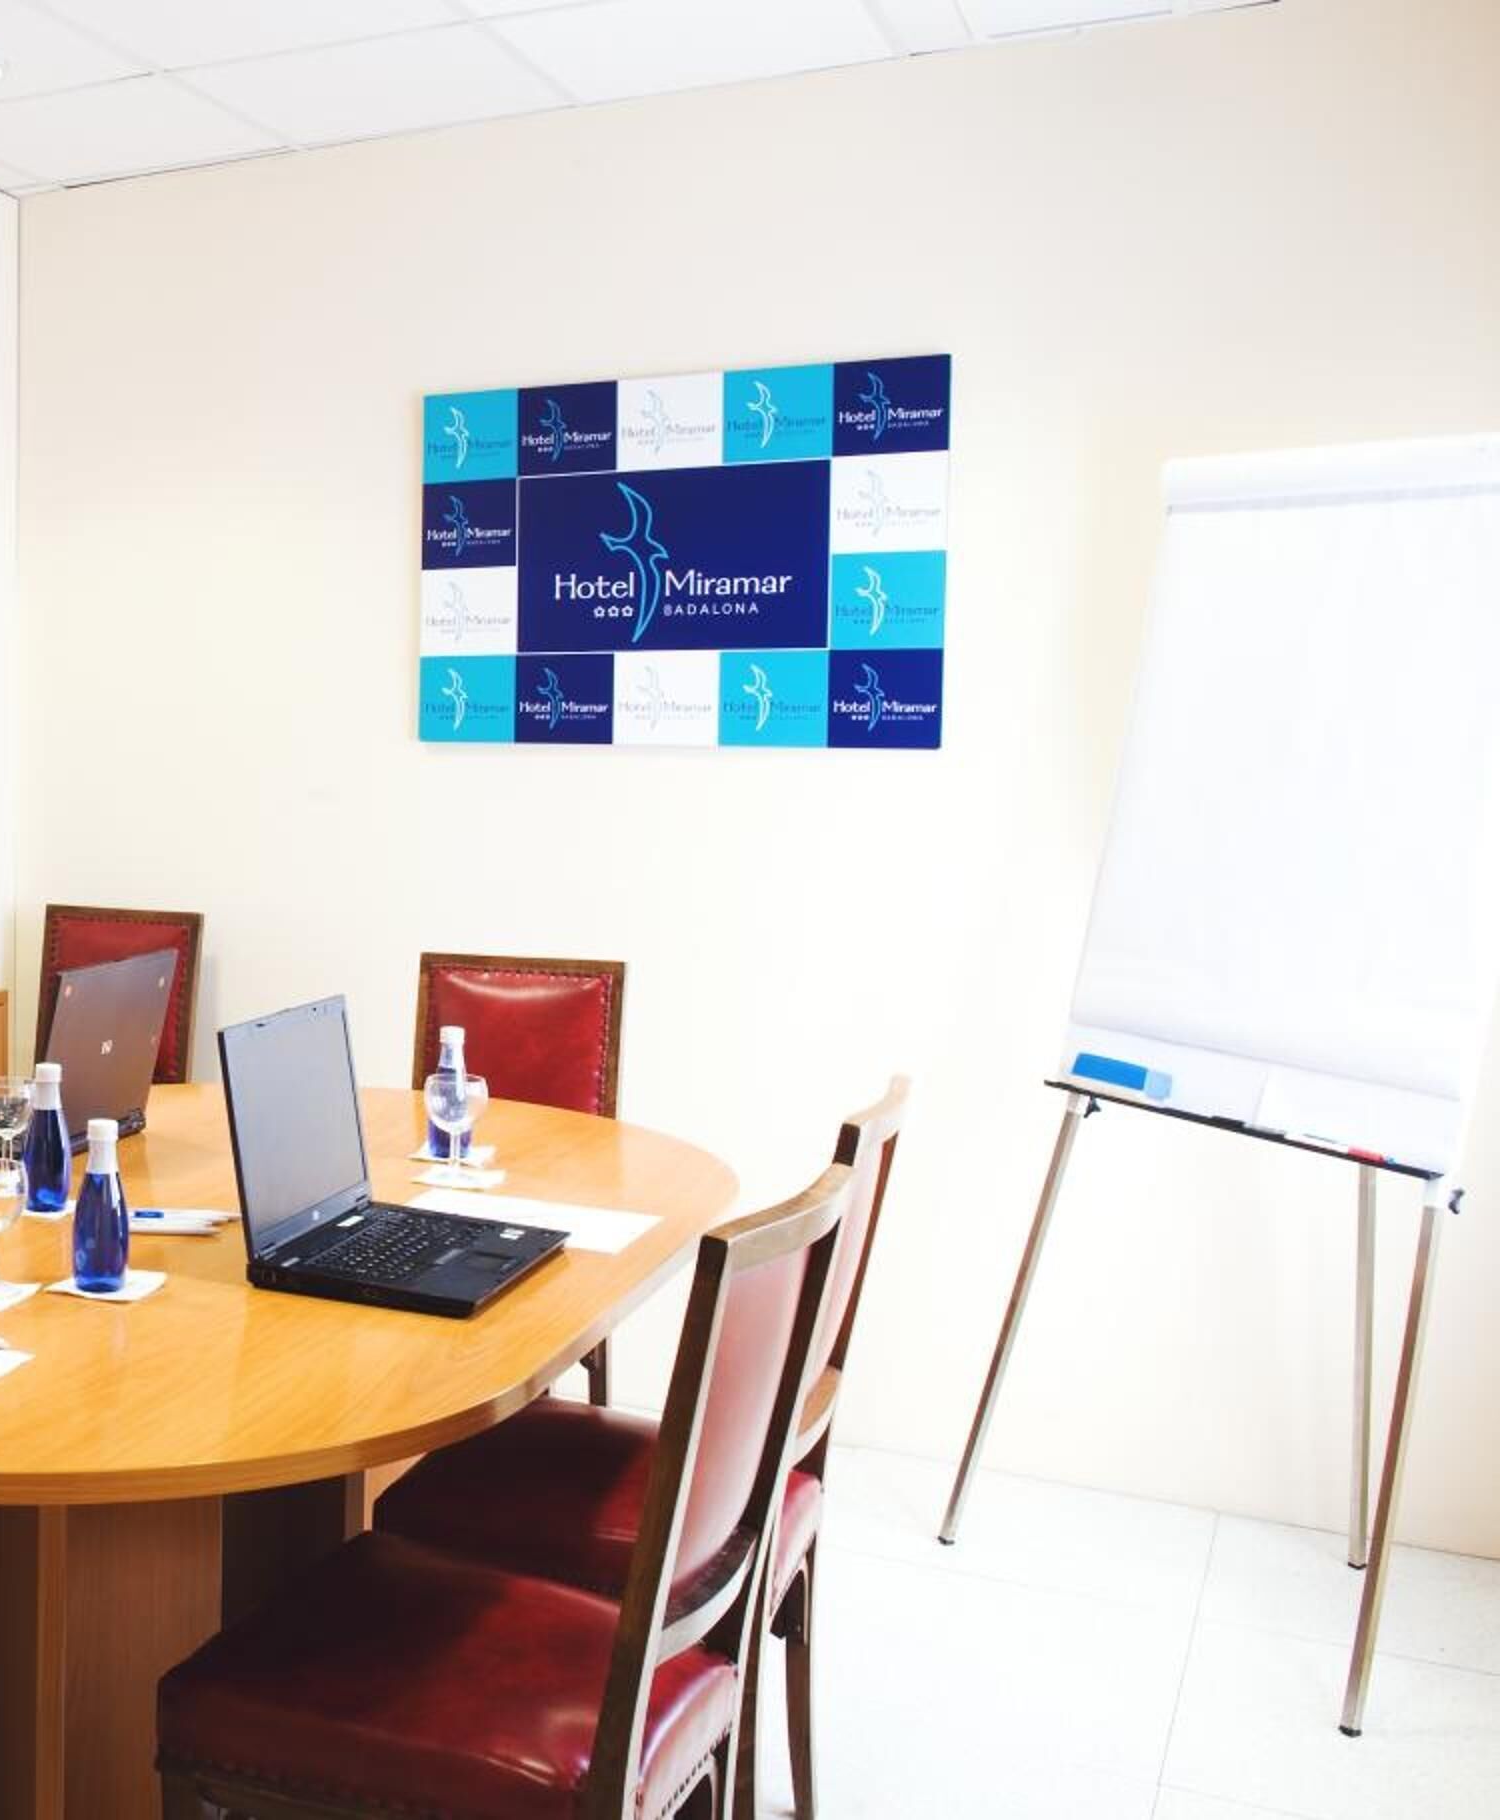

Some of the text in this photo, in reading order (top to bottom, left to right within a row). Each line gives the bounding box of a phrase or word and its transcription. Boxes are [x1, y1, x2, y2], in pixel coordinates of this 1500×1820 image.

[839, 408, 944, 424] Hotel Miramar
[521, 432, 555, 446] Hotel
[564, 431, 612, 444] Miramar
[427, 528, 511, 541] Hotel Miramar
[555, 569, 793, 600] Hotel Miramar
[663, 601, 760, 617] BADALONA
[519, 701, 609, 713] Hotel Miramar
[833, 700, 937, 713] Hotel Miramar
